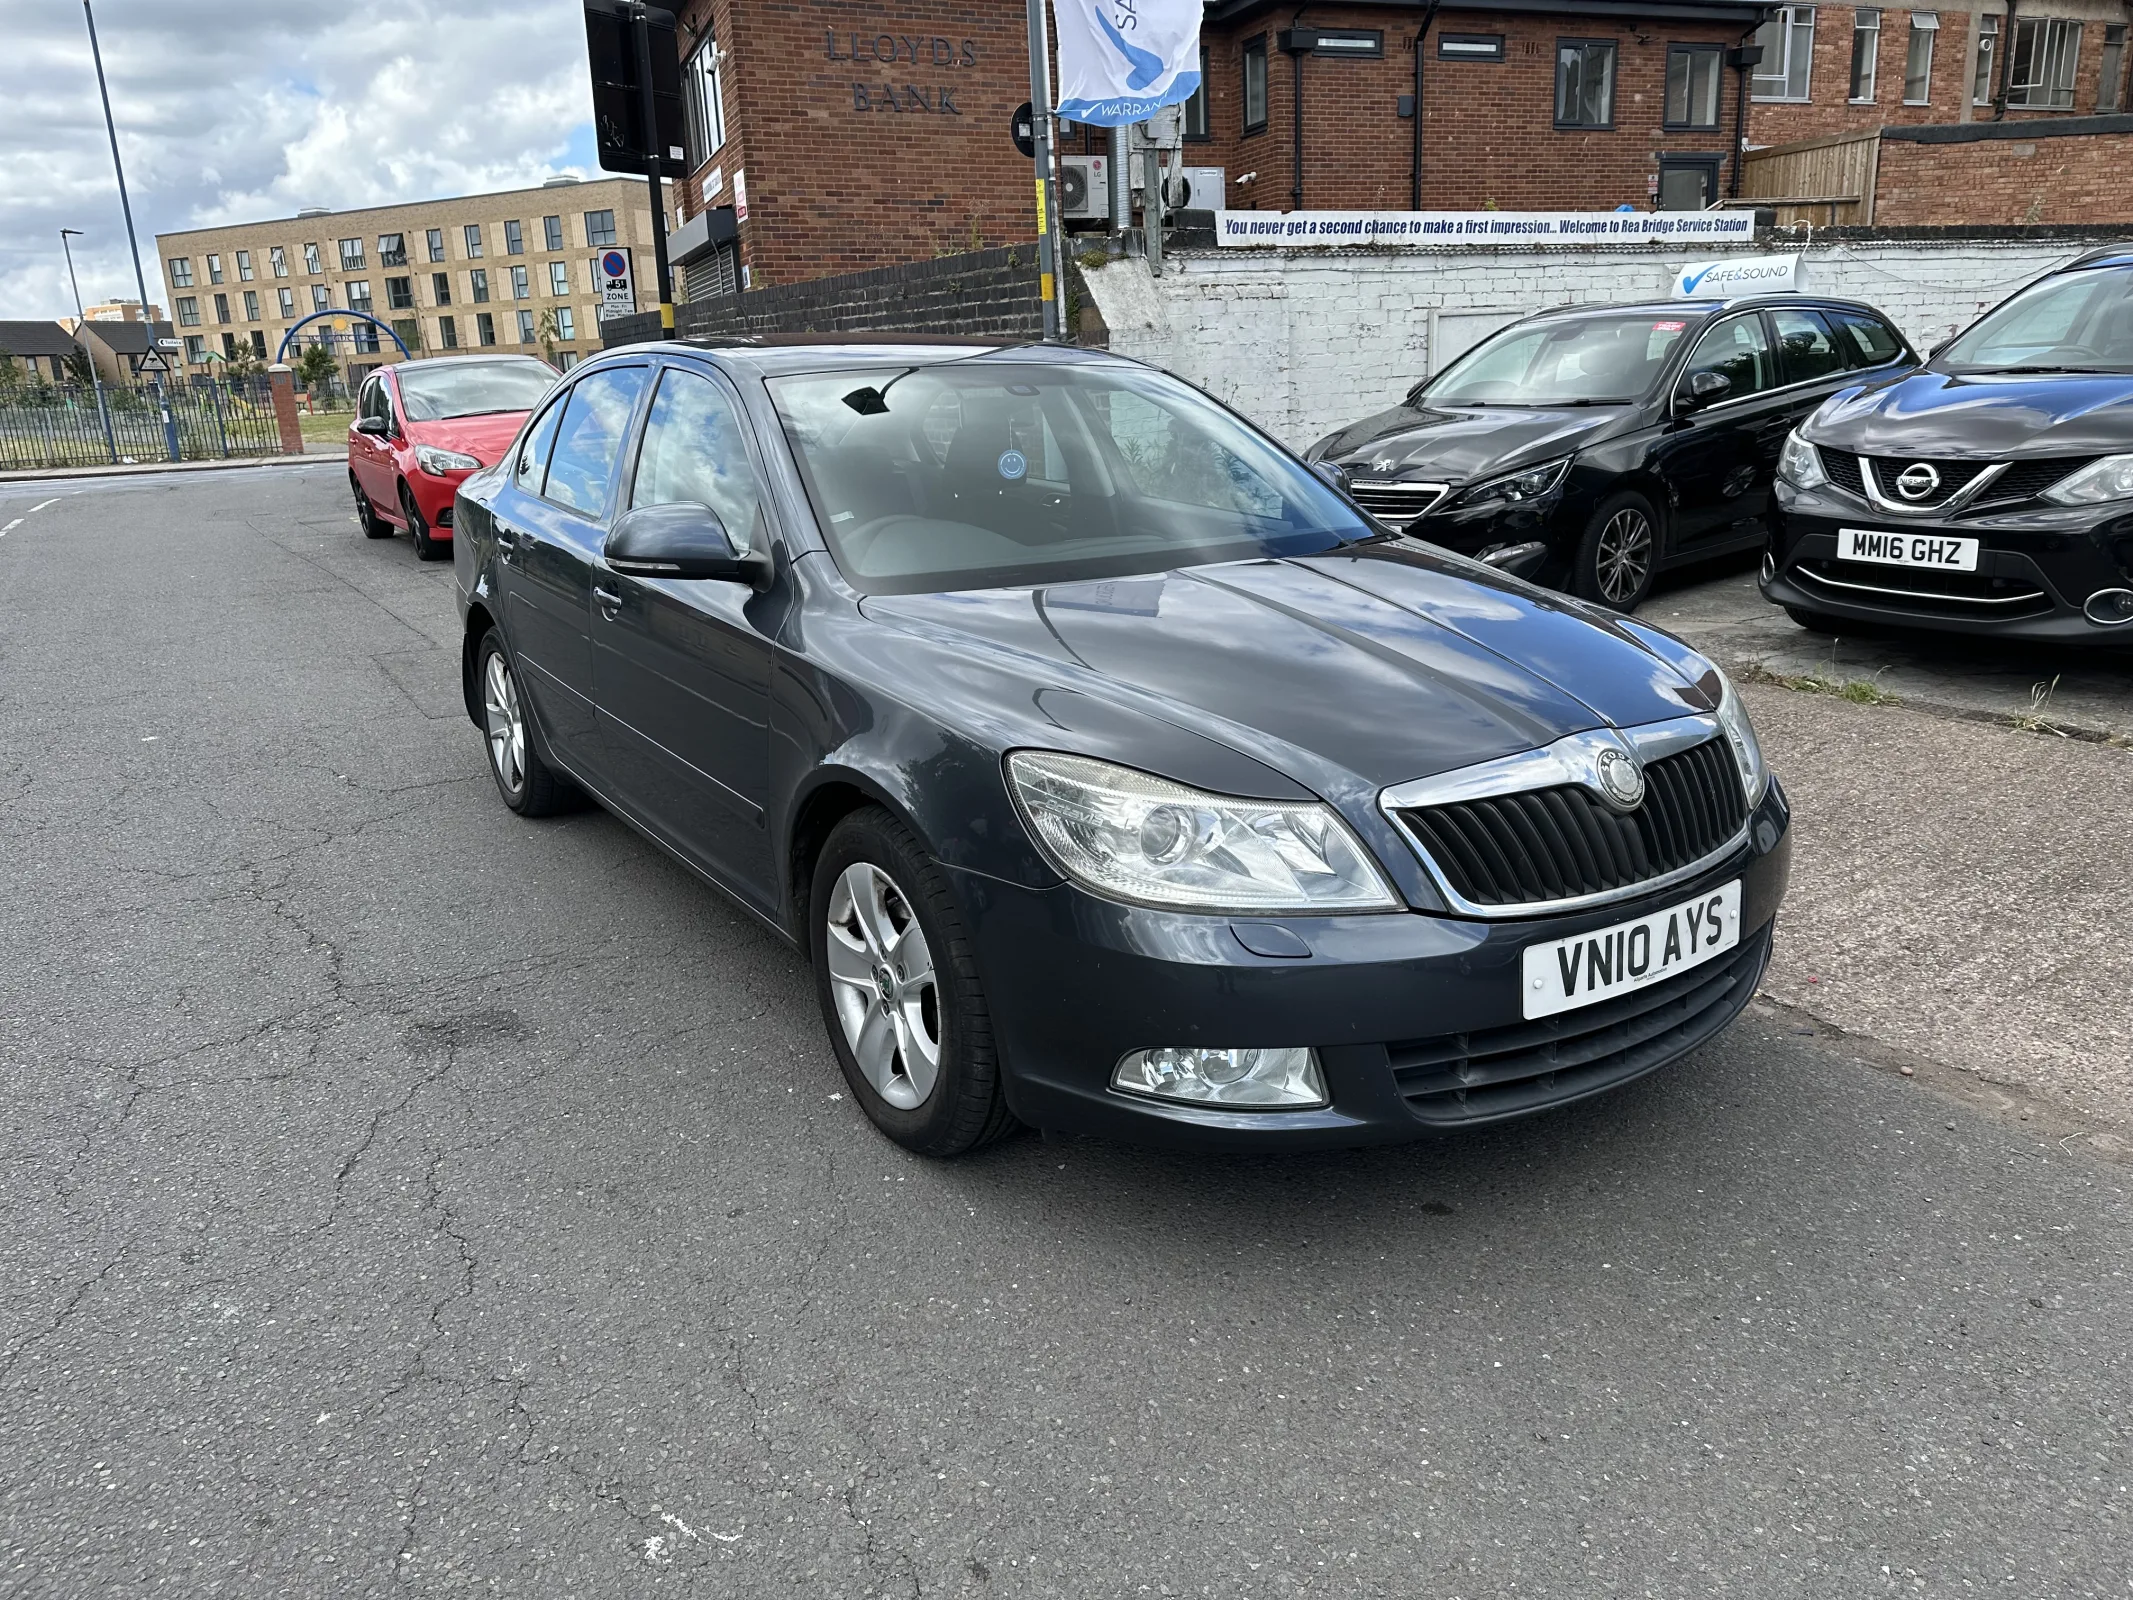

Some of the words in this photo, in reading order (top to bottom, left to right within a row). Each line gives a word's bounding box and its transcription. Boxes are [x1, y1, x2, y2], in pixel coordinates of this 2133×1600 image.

[826, 31, 976, 66] LLOYDS
[852, 82, 963, 115] BANK
[1226, 219, 1248, 235] You
[1250, 221, 1286, 235] never
[1287, 220, 1308, 237] get
[1309, 221, 1318, 235] a
[1319, 219, 1364, 235] second
[1364, 219, 1408, 234] chance
[1409, 220, 1422, 234] to
[1423, 219, 1455, 234] make
[1456, 221, 1464, 234] a
[1465, 219, 1489, 234] first
[1490, 219, 1558, 235] impression...
[1560, 219, 1608, 234] Welcome
[1609, 220, 1620, 233] to
[1621, 219, 1640, 233] Rea
[1642, 218, 1675, 235] Bridge
[1676, 218, 1713, 232] Service
[1714, 218, 1749, 232] Station
[1705, 265, 1788, 283] SAFE&SOUND
[1900, 478, 1932, 486] NISSAN
[1852, 533, 1904, 559] MM16
[1911, 538, 1962, 564] GHZ
[1601, 751, 1634, 772] SKODA
[1557, 924, 1650, 997] VN10
[1662, 895, 1723, 966] AYS
